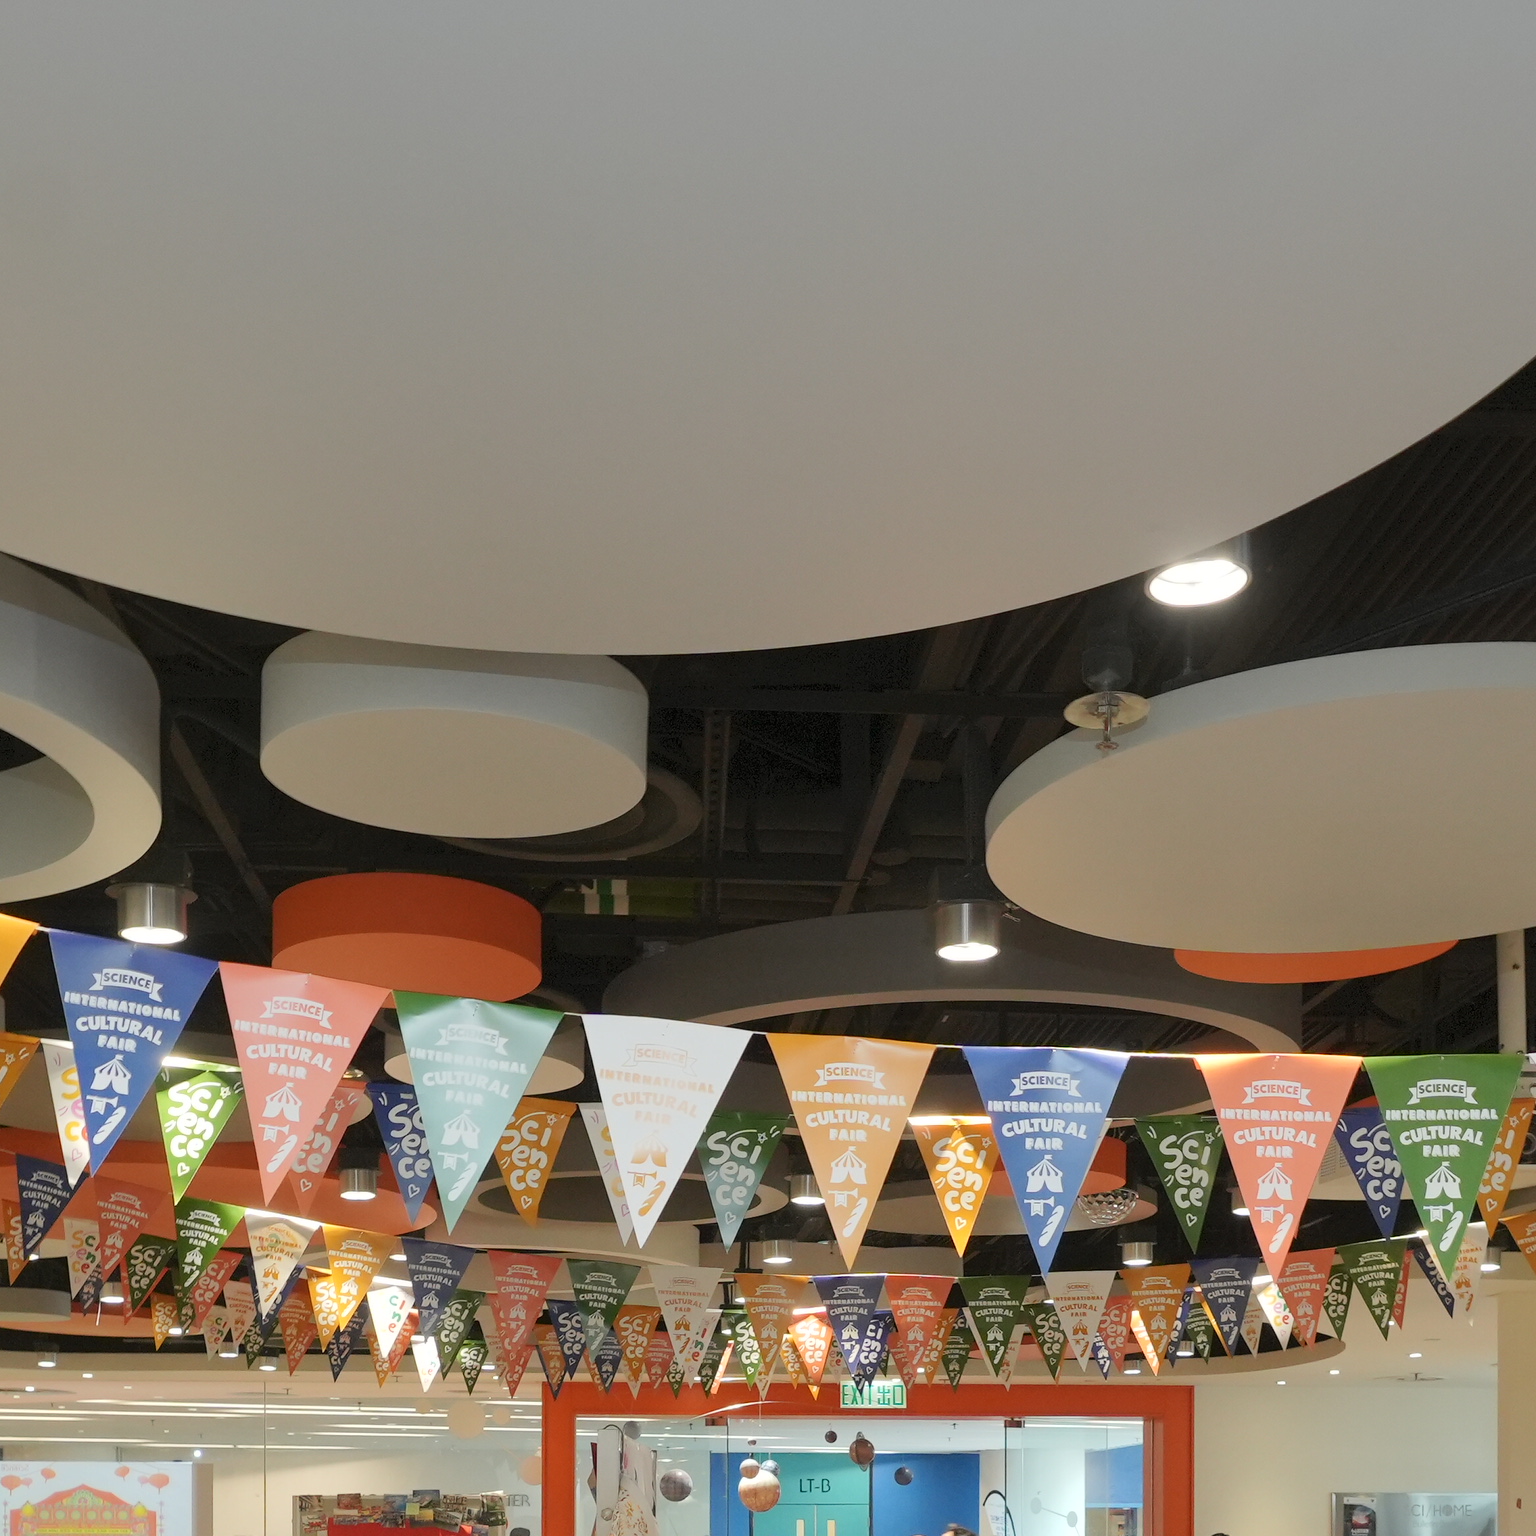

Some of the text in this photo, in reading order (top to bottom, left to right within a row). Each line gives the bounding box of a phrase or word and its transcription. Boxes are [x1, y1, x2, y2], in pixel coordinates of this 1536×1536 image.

[103, 972, 151, 989] SCIENCE
[64, 991, 181, 1022] INTERNATIONAL
[274, 1000, 321, 1016] SCIENCE
[75, 1016, 163, 1045] CULTURAL
[235, 1019, 351, 1048] INTERNATIONAL
[97, 1034, 137, 1052] FAIR
[246, 1044, 333, 1072] CULTURAL
[267, 1062, 307, 1079] FAIR
[826, 1067, 873, 1078] SCIENCE
[1021, 1075, 1068, 1086] SCIENCE
[1253, 1084, 1299, 1095] SCIENCE
[1418, 1083, 1464, 1094] SCIENCE
[792, 1090, 906, 1106] INTERNATIONAL
[987, 1100, 1102, 1113] INTERNATIONAL
[805, 1109, 891, 1132] CULTURAL
[1220, 1108, 1332, 1122] INTERNATIONAL
[1385, 1108, 1498, 1121] INTERNATIONAL
[829, 1128, 867, 1141] FAIR
[1001, 1118, 1087, 1139] CULTURAL
[1399, 1125, 1483, 1145] CULTURAL
[1025, 1137, 1063, 1150] FAIR
[1233, 1126, 1316, 1148] CULTURAL
[1256, 1145, 1293, 1157] FAIR
[1423, 1145, 1460, 1157] FAIR
[409, 1264, 460, 1275] INTERNATIONAL
[1350, 1263, 1399, 1273] INTERNATIONAL
[414, 1275, 452, 1287] CULTURAL
[1357, 1273, 1394, 1284] CULTURAL
[574, 1284, 625, 1294] INTERNATIONAL
[579, 1294, 617, 1305] CULTURAL
[830, 1306, 868, 1315] CULTURAL
[975, 1308, 1013, 1317] CULTURAL
[877, 1385, 904, 1405] 出口
[799, 1478, 831, 1493] LT-B
[1411, 1504, 1473, 1517] CI/HOME
